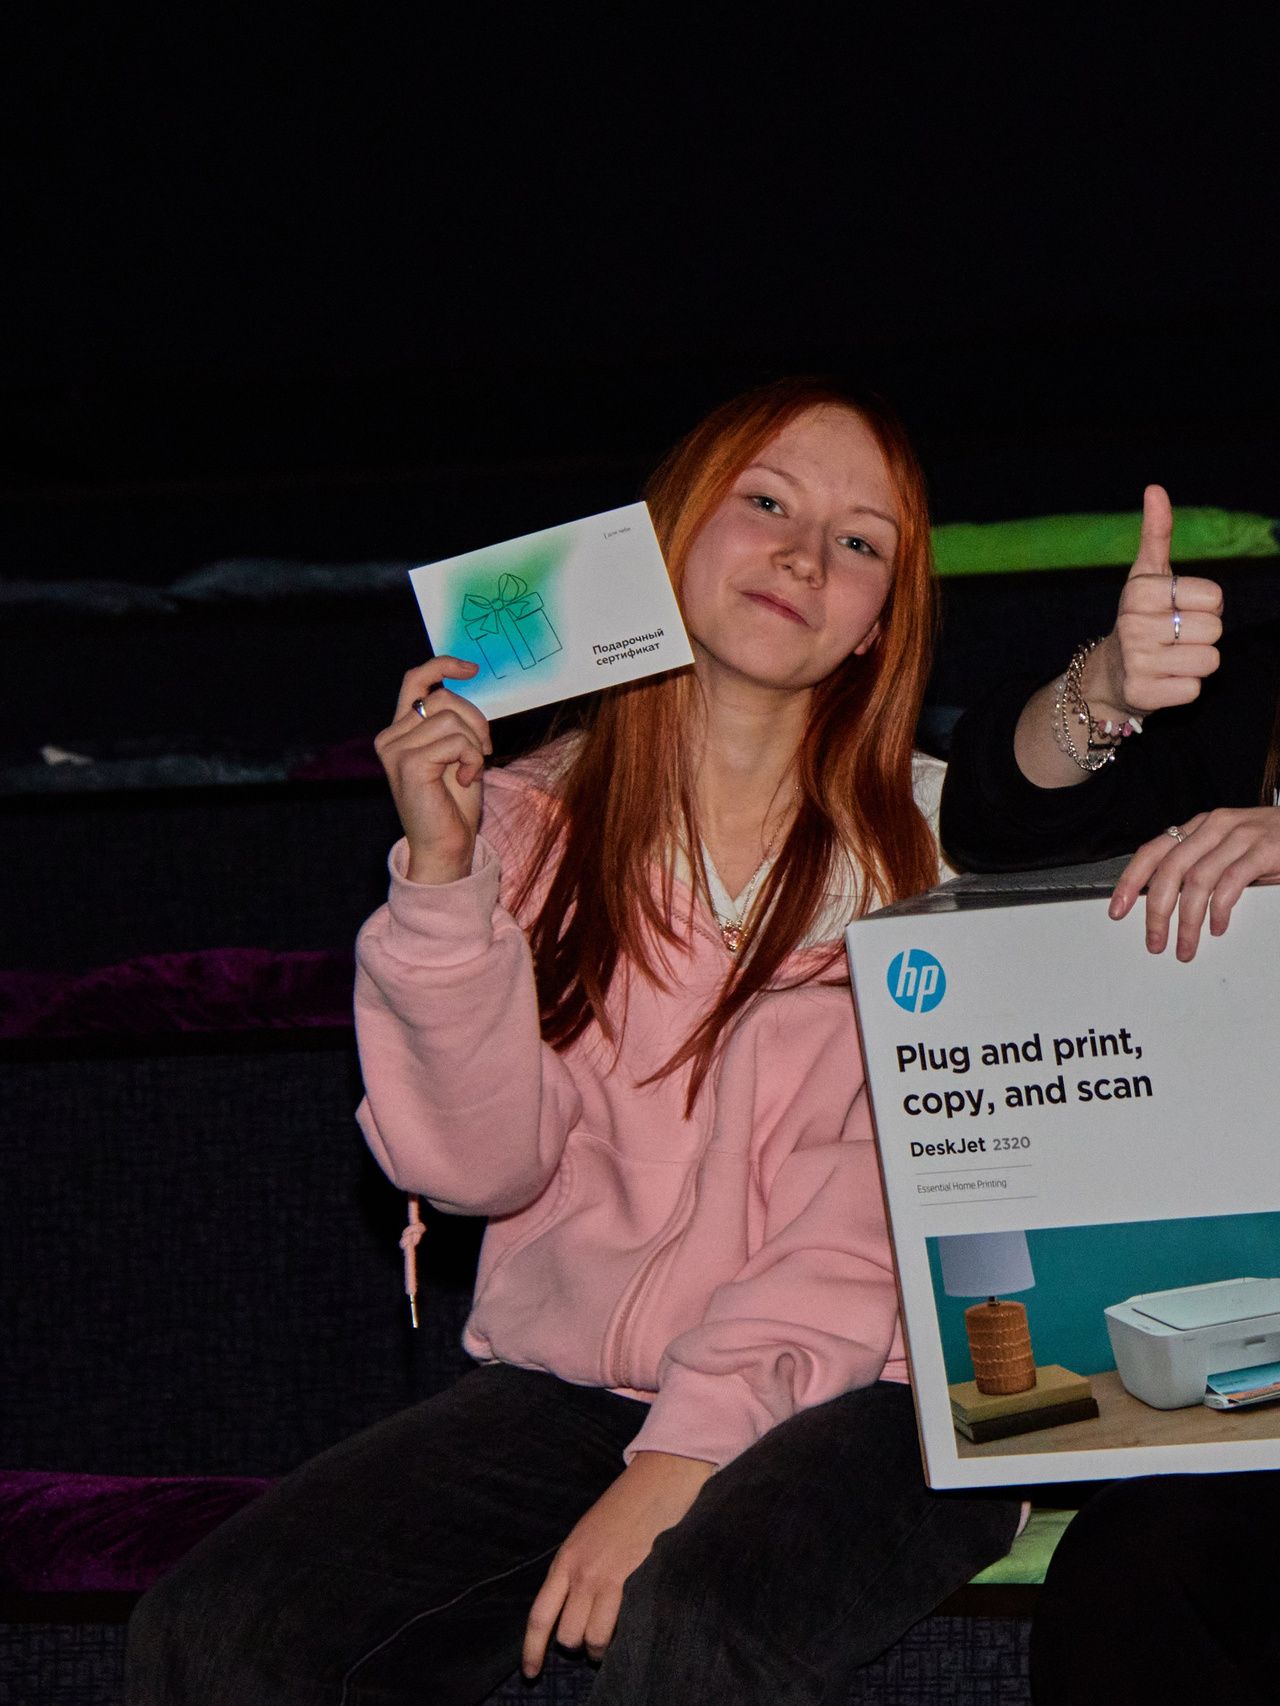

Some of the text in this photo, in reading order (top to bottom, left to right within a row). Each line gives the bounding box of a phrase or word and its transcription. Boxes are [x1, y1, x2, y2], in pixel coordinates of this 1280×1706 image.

[592, 628, 665, 655] Подарочный
[596, 642, 660, 666] сертификат
[890, 949, 945, 1013] hp
[896, 1028, 1142, 1074] Plug and print,
[903, 1074, 1153, 1119] copy, and scan
[910, 1136, 1031, 1157] DeskJet 2320
[917, 1179, 1007, 1194] Essential Home Printing
